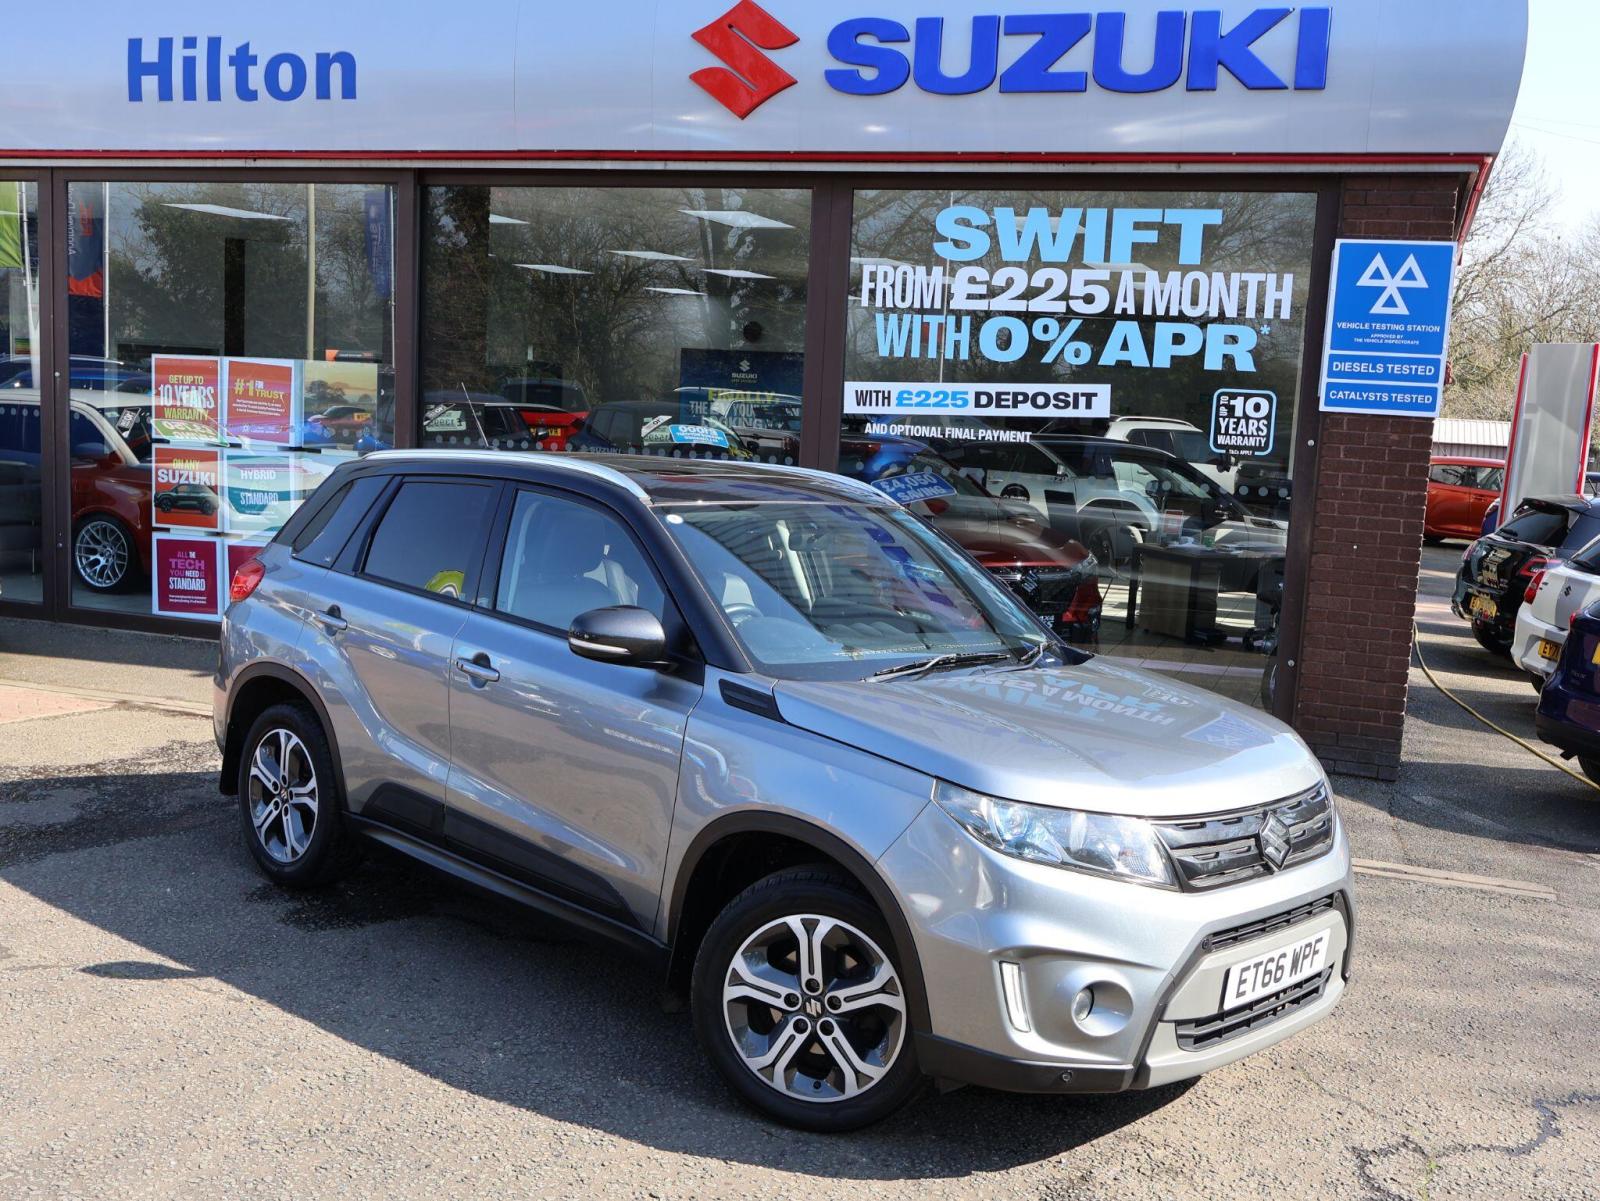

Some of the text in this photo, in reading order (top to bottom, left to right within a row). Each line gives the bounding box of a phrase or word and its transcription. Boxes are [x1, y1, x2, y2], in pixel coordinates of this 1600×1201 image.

[824, 7, 1333, 95] SUZUKI
[127, 36, 357, 102] Hilton
[933, 205, 1223, 265] SWIFT
[861, 264, 1294, 320] FROM £225 A MONTH
[1336, 321, 1441, 333] VEHICLE TESTING STATION
[875, 313, 970, 360] WITH
[979, 317, 1092, 365] 0%
[1332, 361, 1435, 375] DIESELS TESTED
[168, 374, 204, 385] GET UP TO
[234, 378, 254, 396] #1
[159, 384, 173, 407] 10
[174, 385, 215, 409] YEARS
[256, 389, 285, 400] TRUST
[855, 389, 1099, 411] WITH £225 DEPOSIT
[1329, 390, 1433, 404] CATALYSTS TESTED
[164, 407, 210, 421] WARRANTY
[1218, 395, 1229, 417] UP TO
[1229, 396, 1270, 418] 10
[864, 423, 1033, 443] AND OPTIONAL FINAL PAYMENT
[1219, 417, 1268, 436] YEARS
[1217, 434, 1266, 447] WARRANTY
[157, 469, 216, 486] SUZUKI
[240, 469, 276, 480] HYBRID
[880, 472, 939, 493] £4,050
[240, 491, 279, 505] STANDARD
[897, 485, 947, 501] SAVING
[177, 551, 189, 559] ALL
[169, 558, 205, 570] TECH
[170, 569, 185, 577] YOU
[169, 577, 206, 591] STANDARD
[1236, 936, 1323, 999] ET66 WPF
